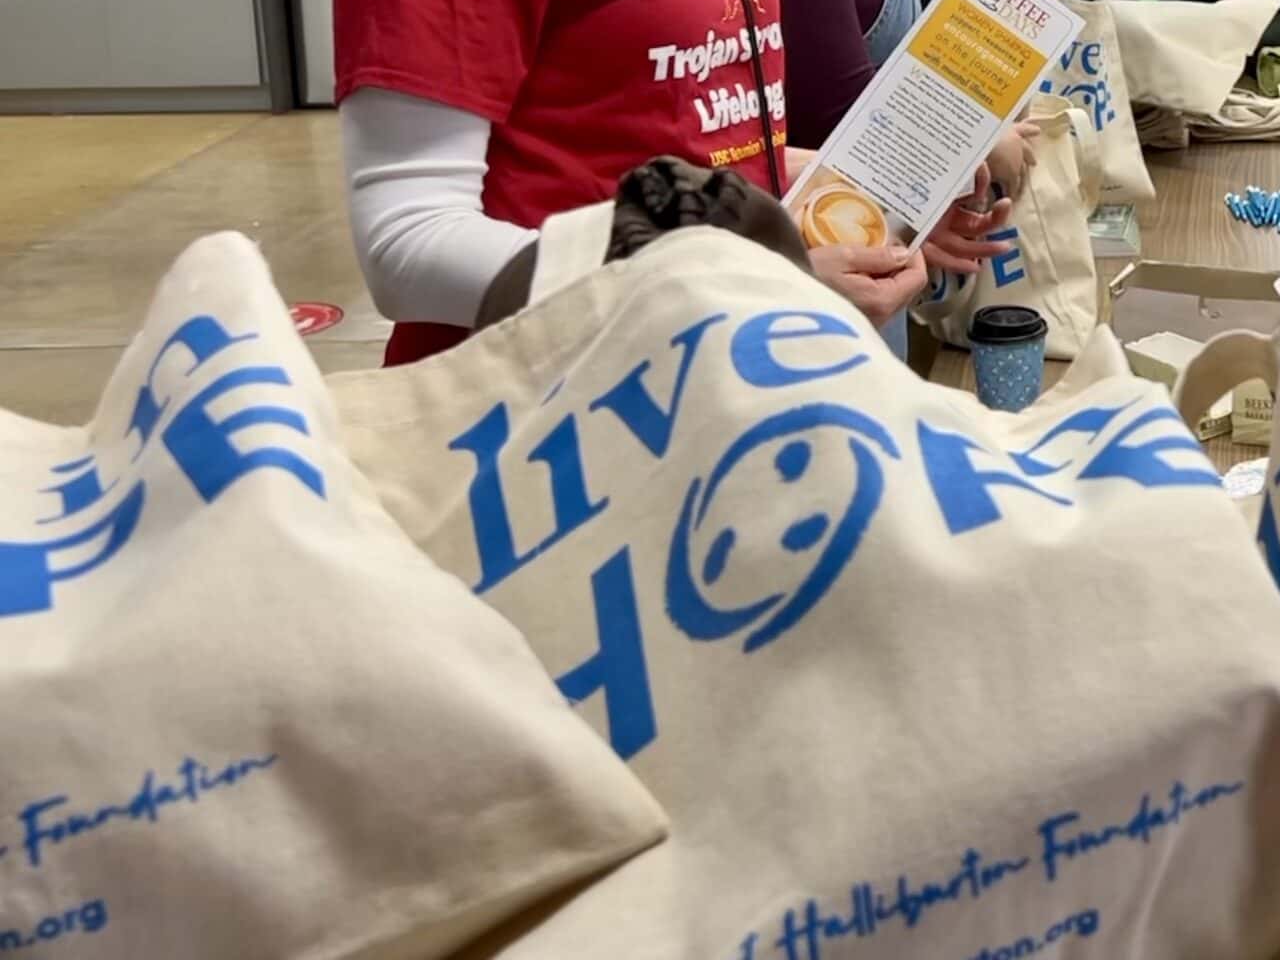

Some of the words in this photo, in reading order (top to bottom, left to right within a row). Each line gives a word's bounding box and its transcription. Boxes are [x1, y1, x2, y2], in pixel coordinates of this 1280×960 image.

[648, 29, 738, 82] Trojan
[996, 2, 1042, 40] DAYS
[18, 752, 279, 868] Foundation
[775, 849, 1028, 960] Halliburton
[1037, 779, 1243, 880] Foundation
